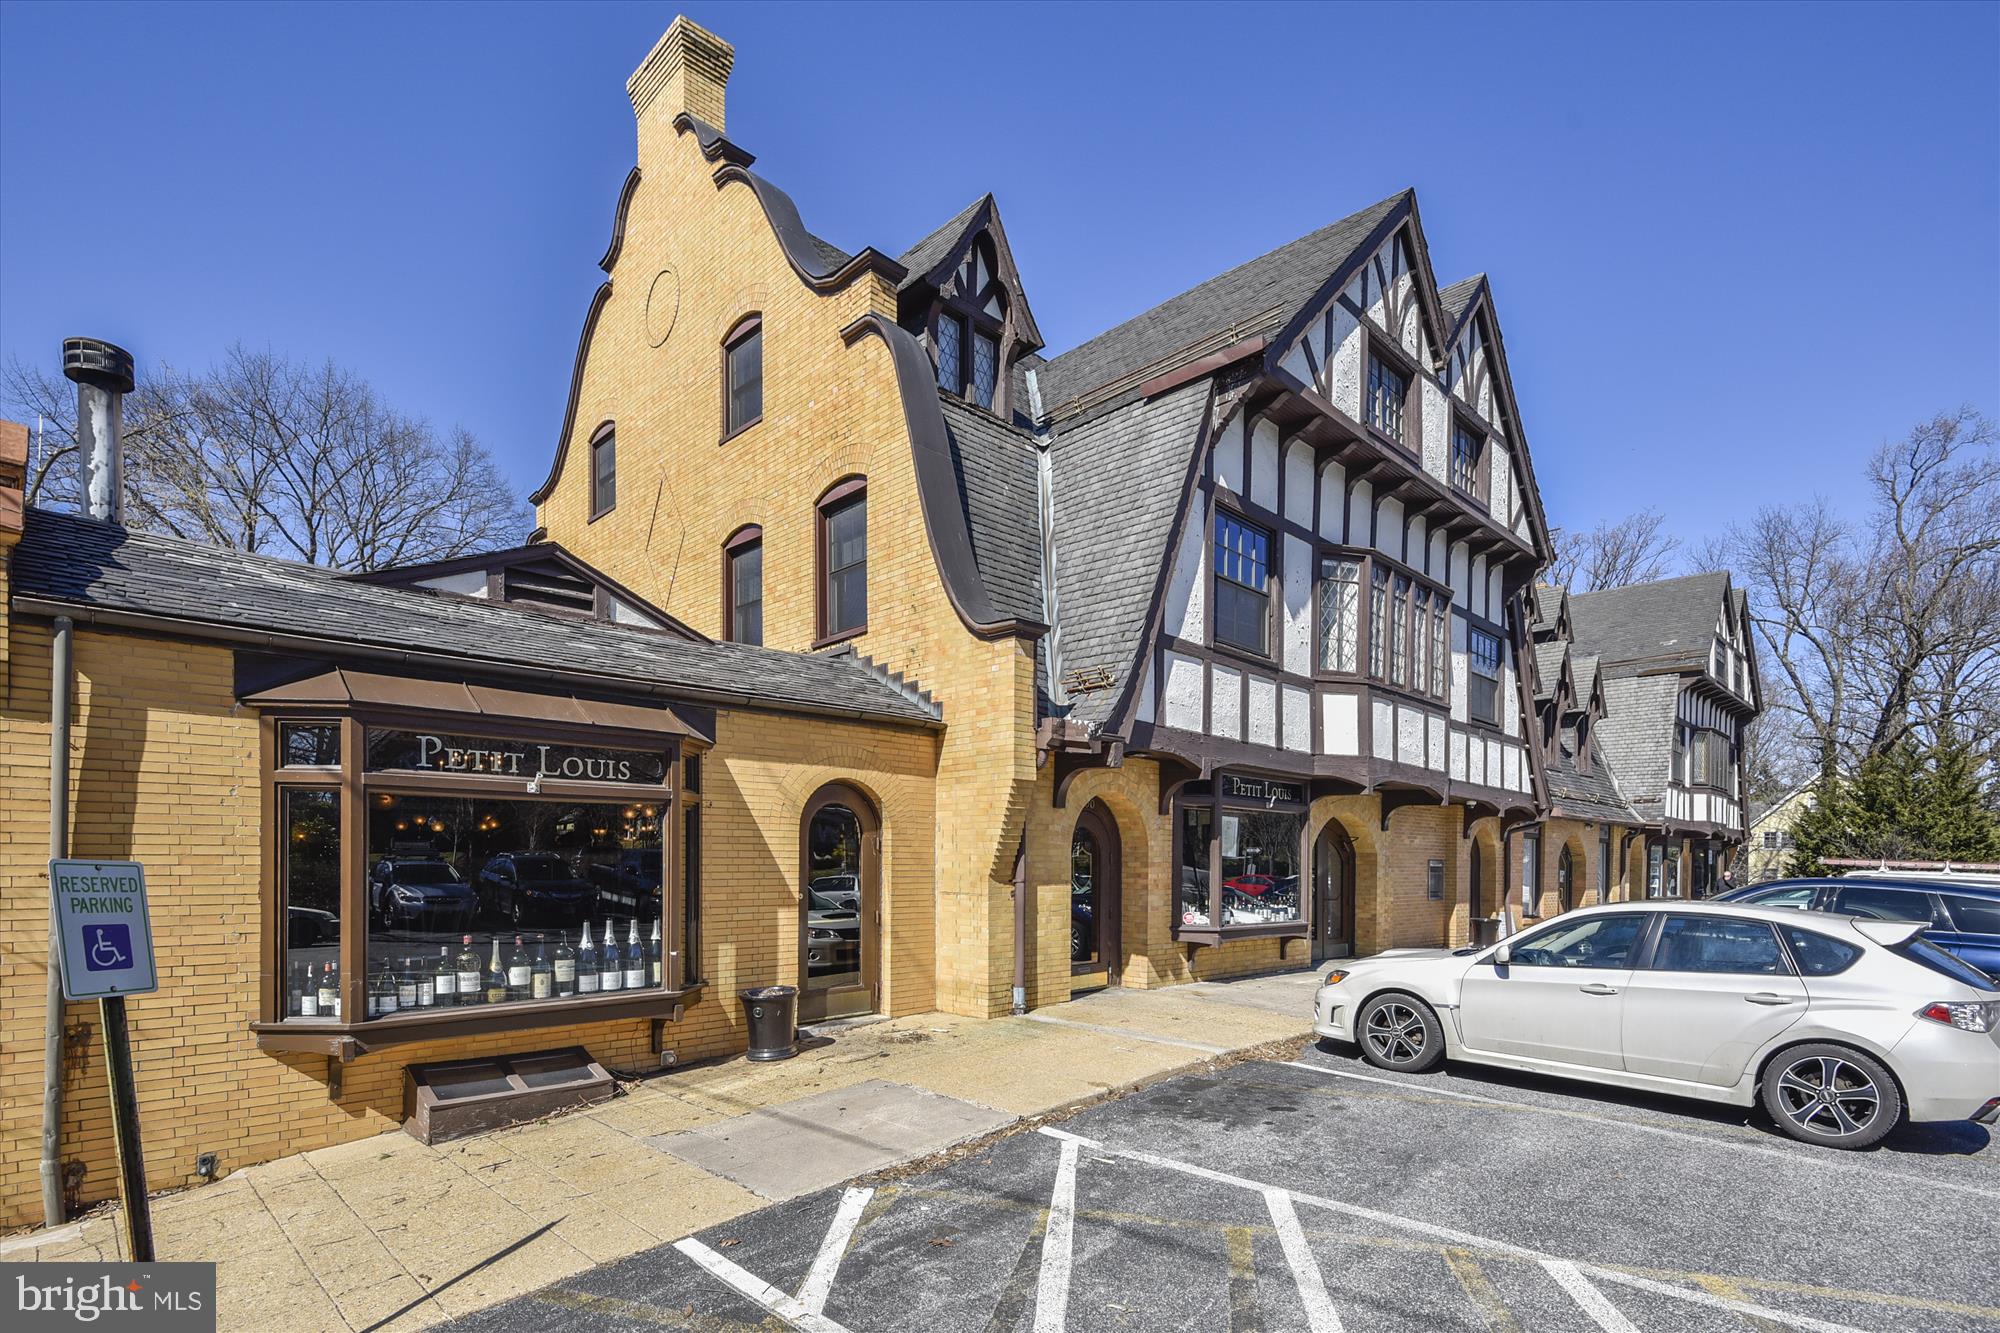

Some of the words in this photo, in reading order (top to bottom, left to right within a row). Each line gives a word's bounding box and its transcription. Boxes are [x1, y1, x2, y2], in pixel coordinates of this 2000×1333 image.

[415, 735, 525, 774] PETIT
[536, 745, 631, 781] LOUIS
[1232, 777, 1262, 798] PETIT
[1264, 781, 1292, 801] LOUIS
[59, 875, 138, 893] RESERVED
[70, 897, 134, 914] PARKING
